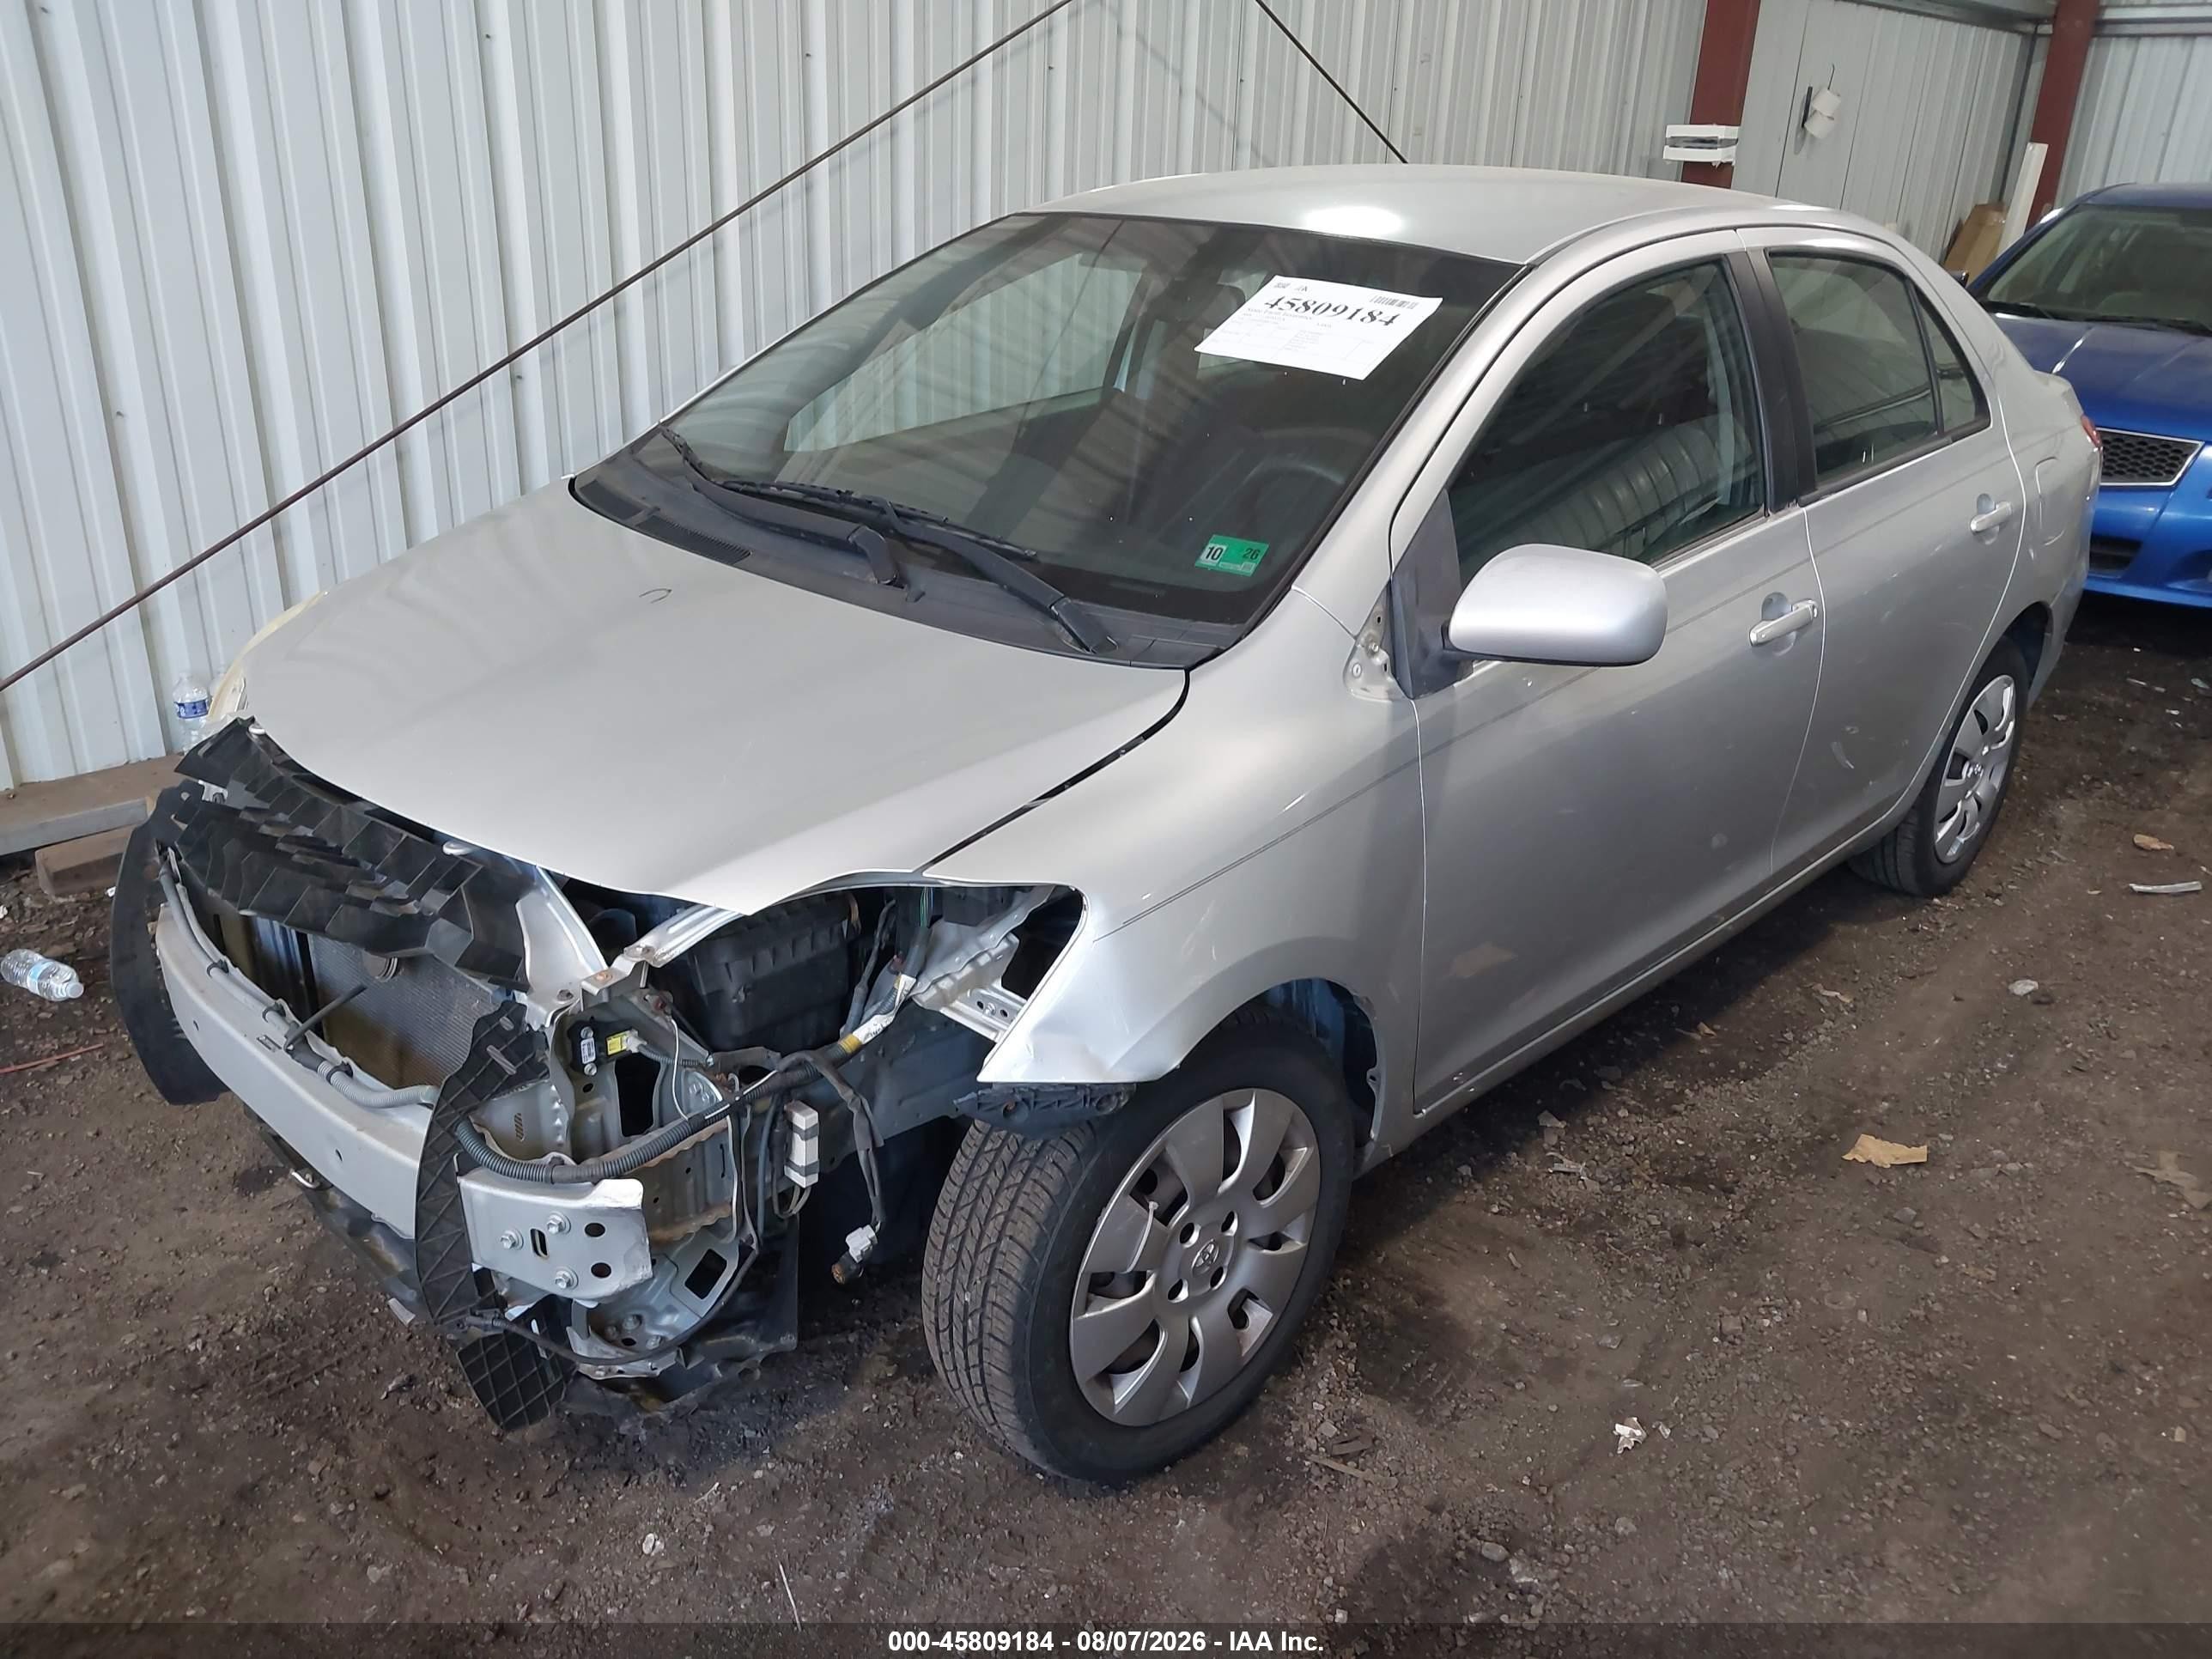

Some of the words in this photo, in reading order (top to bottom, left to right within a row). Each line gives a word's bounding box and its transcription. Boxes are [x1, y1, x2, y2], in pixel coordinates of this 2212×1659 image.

[1265, 295, 1401, 326] 45809184
[1206, 545, 1224, 561] 10
[1243, 547, 1261, 560] 26
